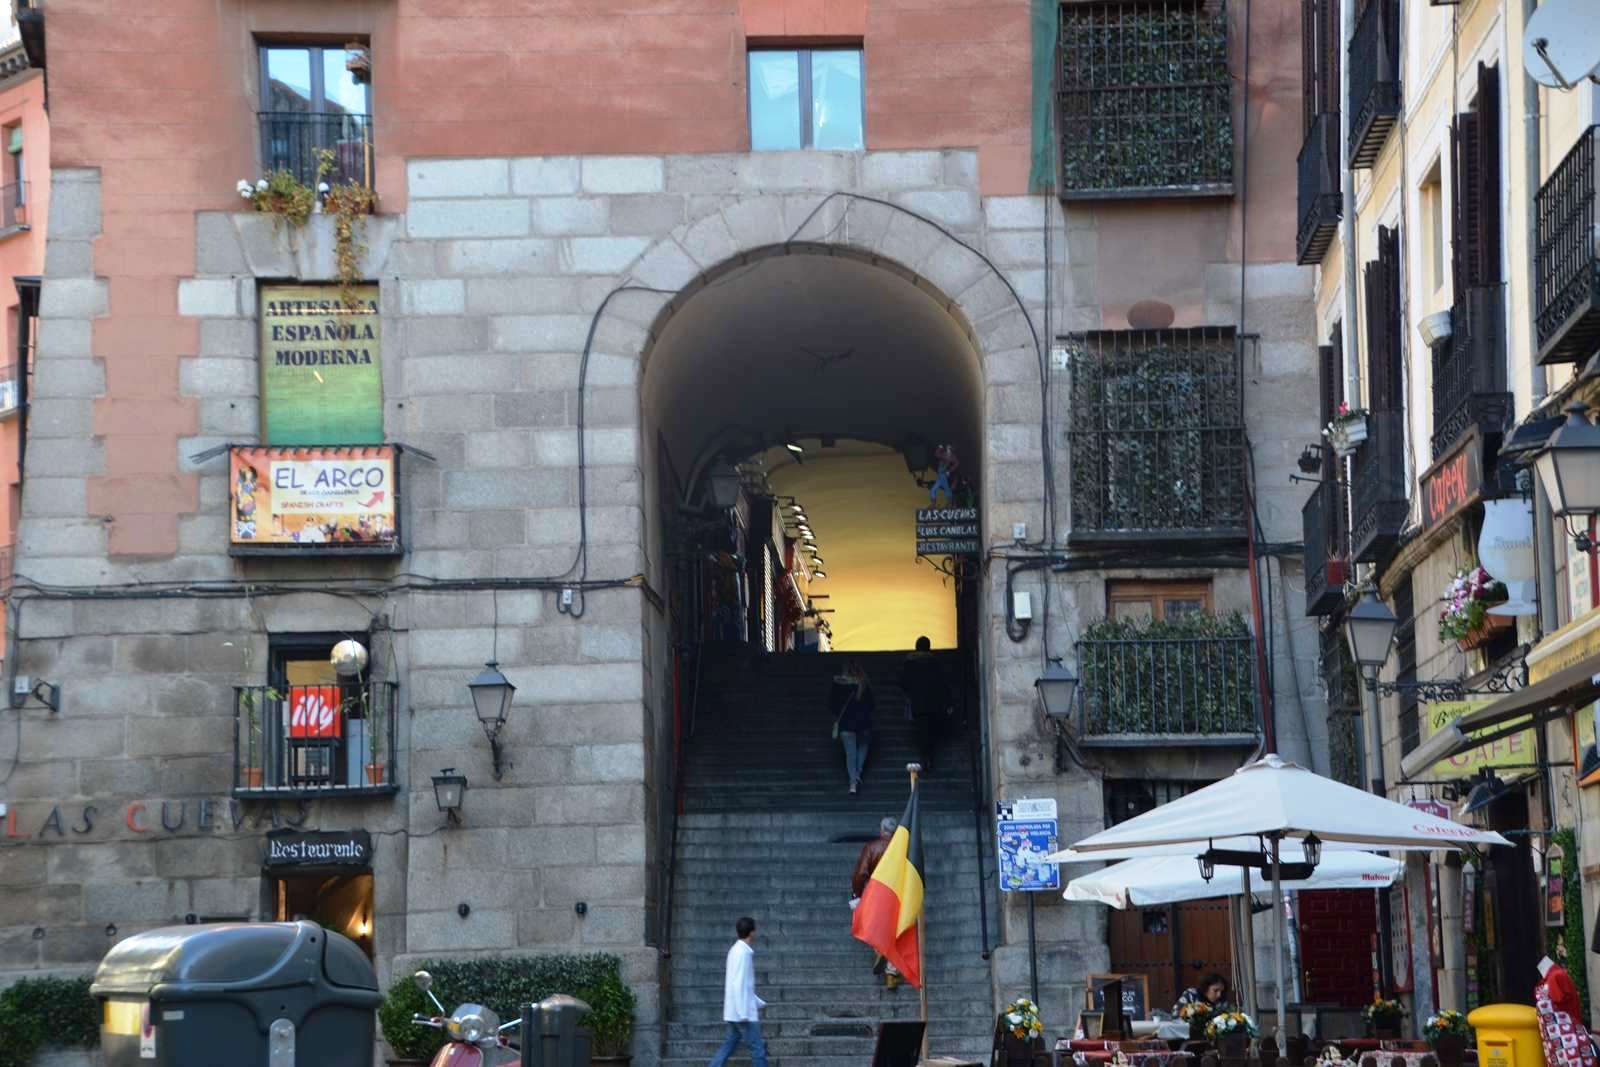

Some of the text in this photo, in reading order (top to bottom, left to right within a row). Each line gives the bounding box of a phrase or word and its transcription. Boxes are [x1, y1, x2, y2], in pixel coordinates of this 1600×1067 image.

[272, 320, 375, 341] ESPAÑOLA
[275, 349, 372, 366] MODERNA
[275, 466, 384, 489] EL ARCO
[919, 508, 977, 521] LAS CUEVAS
[291, 694, 335, 735] illy
[6, 799, 310, 838] LAS CUEVAS
[270, 840, 363, 858] Restaurante
[1361, 872, 1391, 881] Mahou
